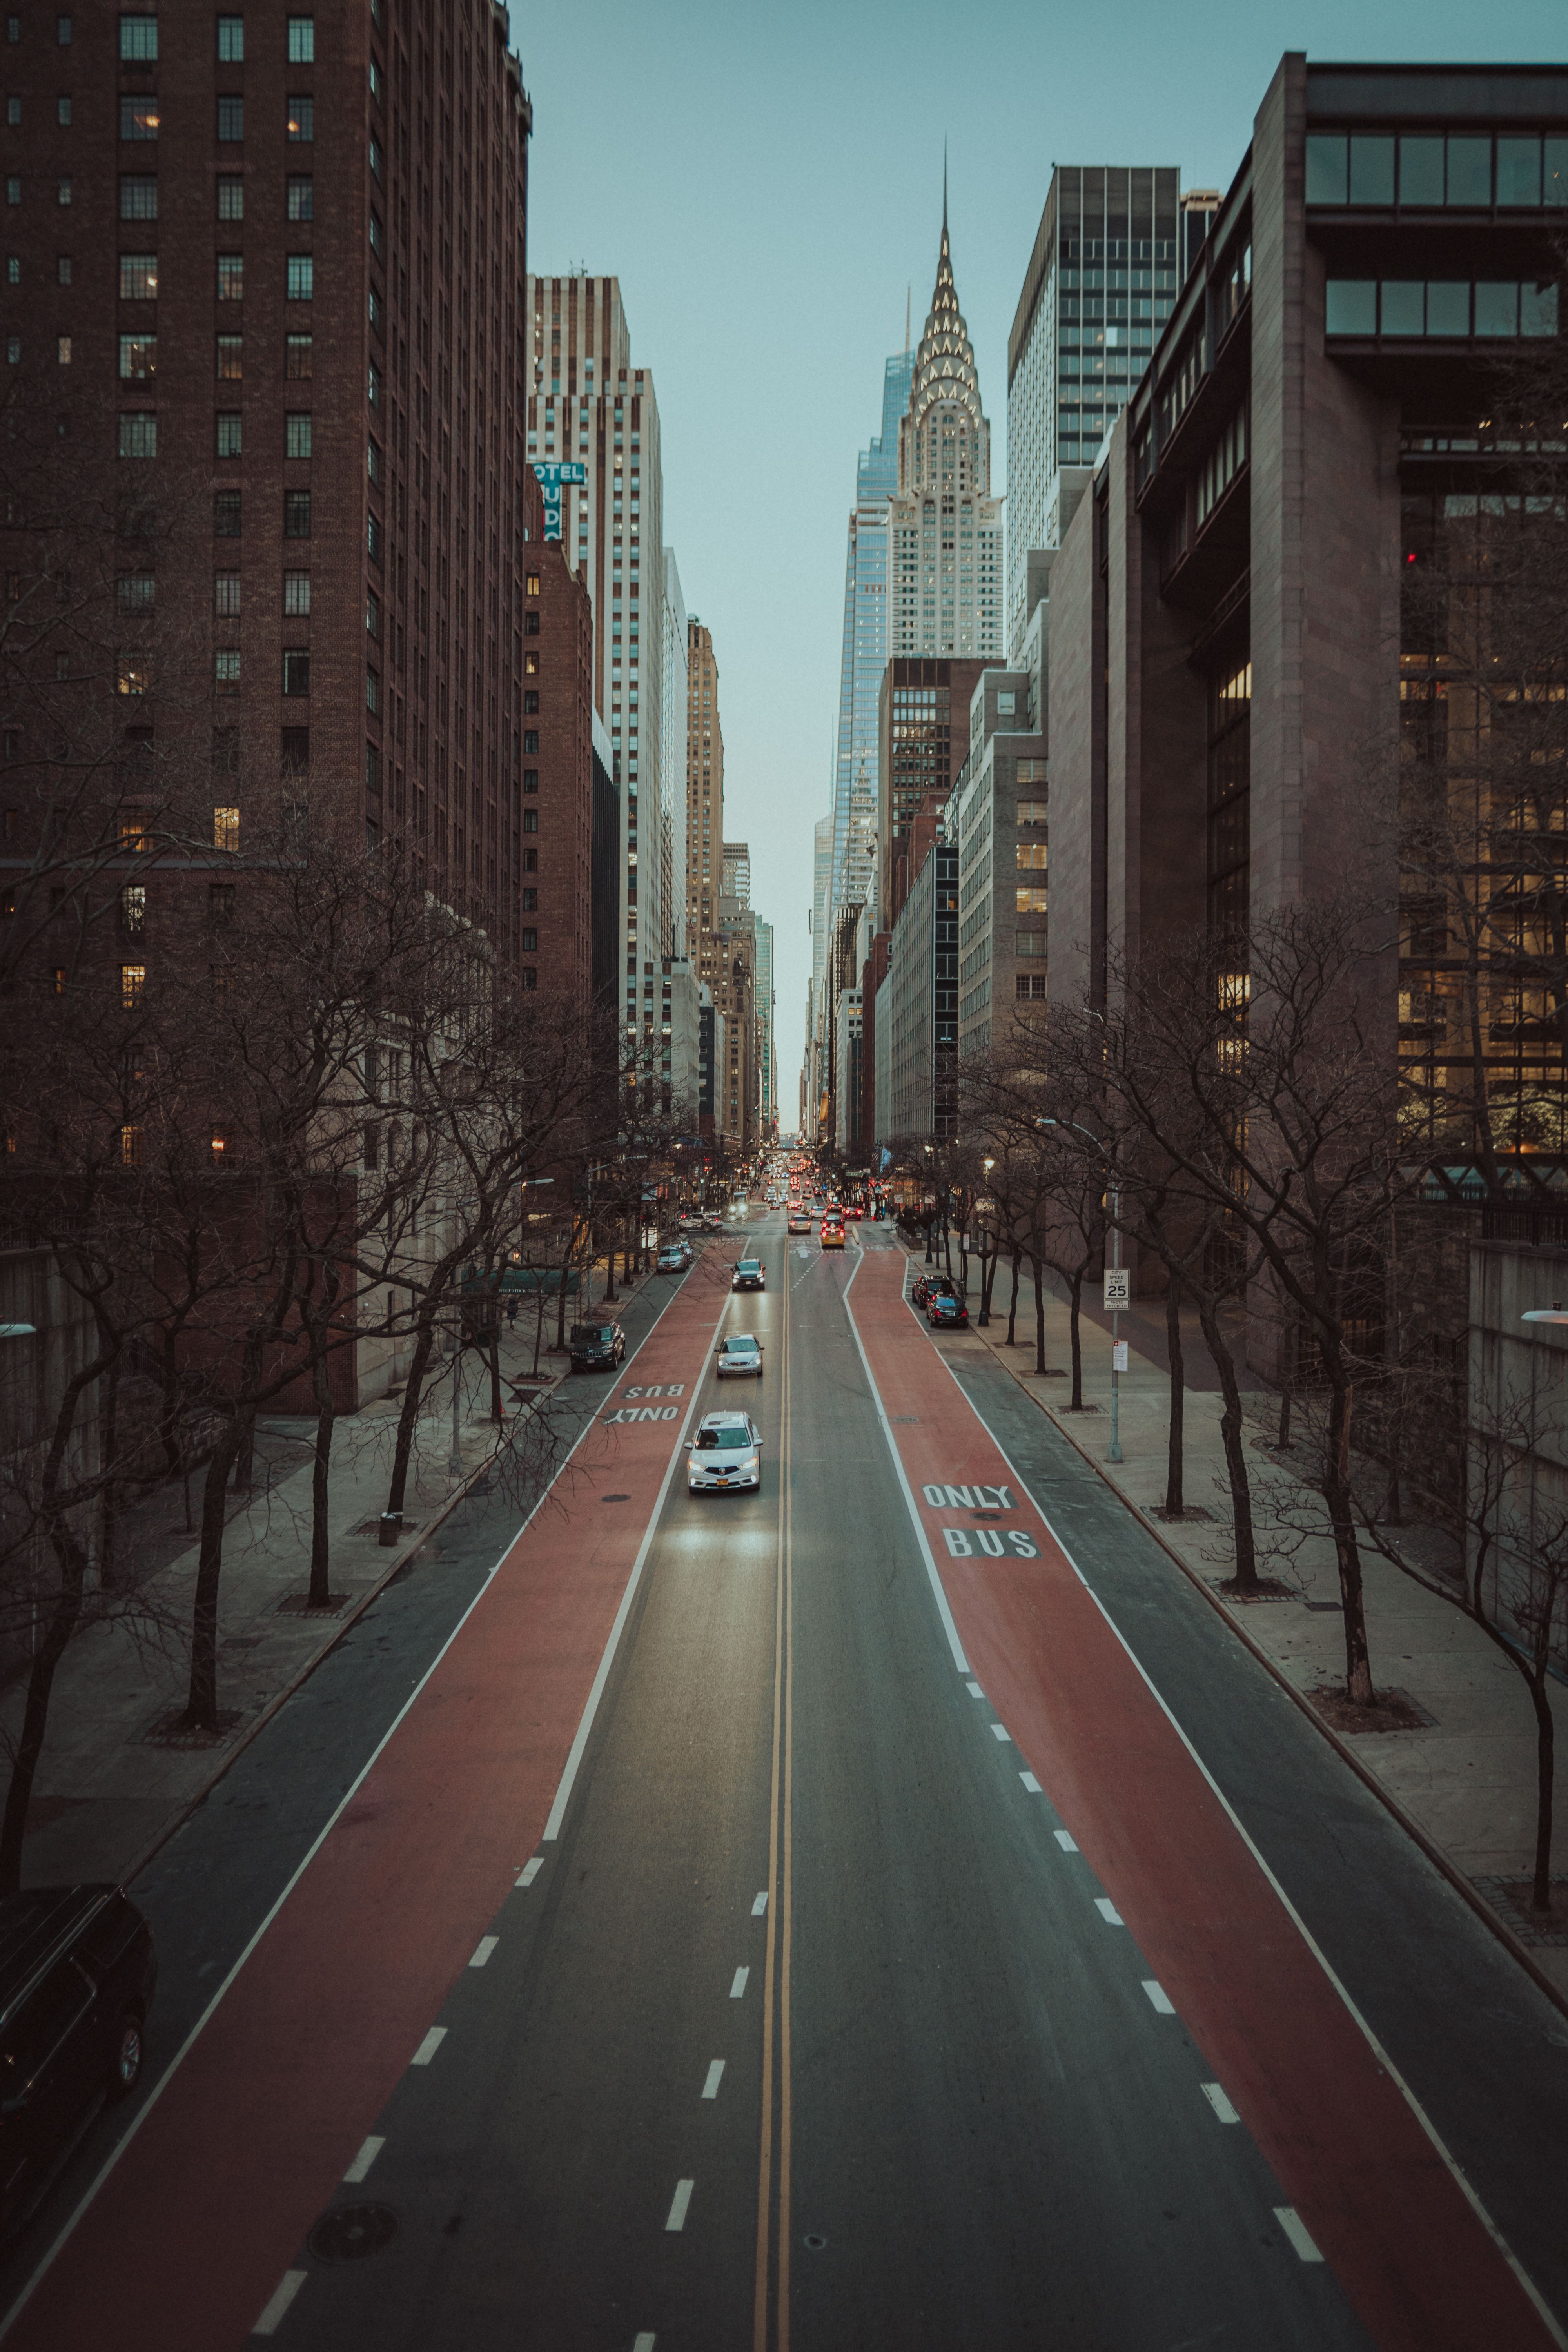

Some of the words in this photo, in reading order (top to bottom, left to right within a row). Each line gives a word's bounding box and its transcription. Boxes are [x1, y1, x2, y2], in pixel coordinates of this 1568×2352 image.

[534, 464, 583, 480] OTEL
[1108, 1286, 1126, 1297] 25
[626, 1384, 685, 1399] BUS
[603, 1407, 679, 1424] ONLY
[923, 1485, 1011, 1508] ONLY
[942, 1528, 1037, 1558] BUS
